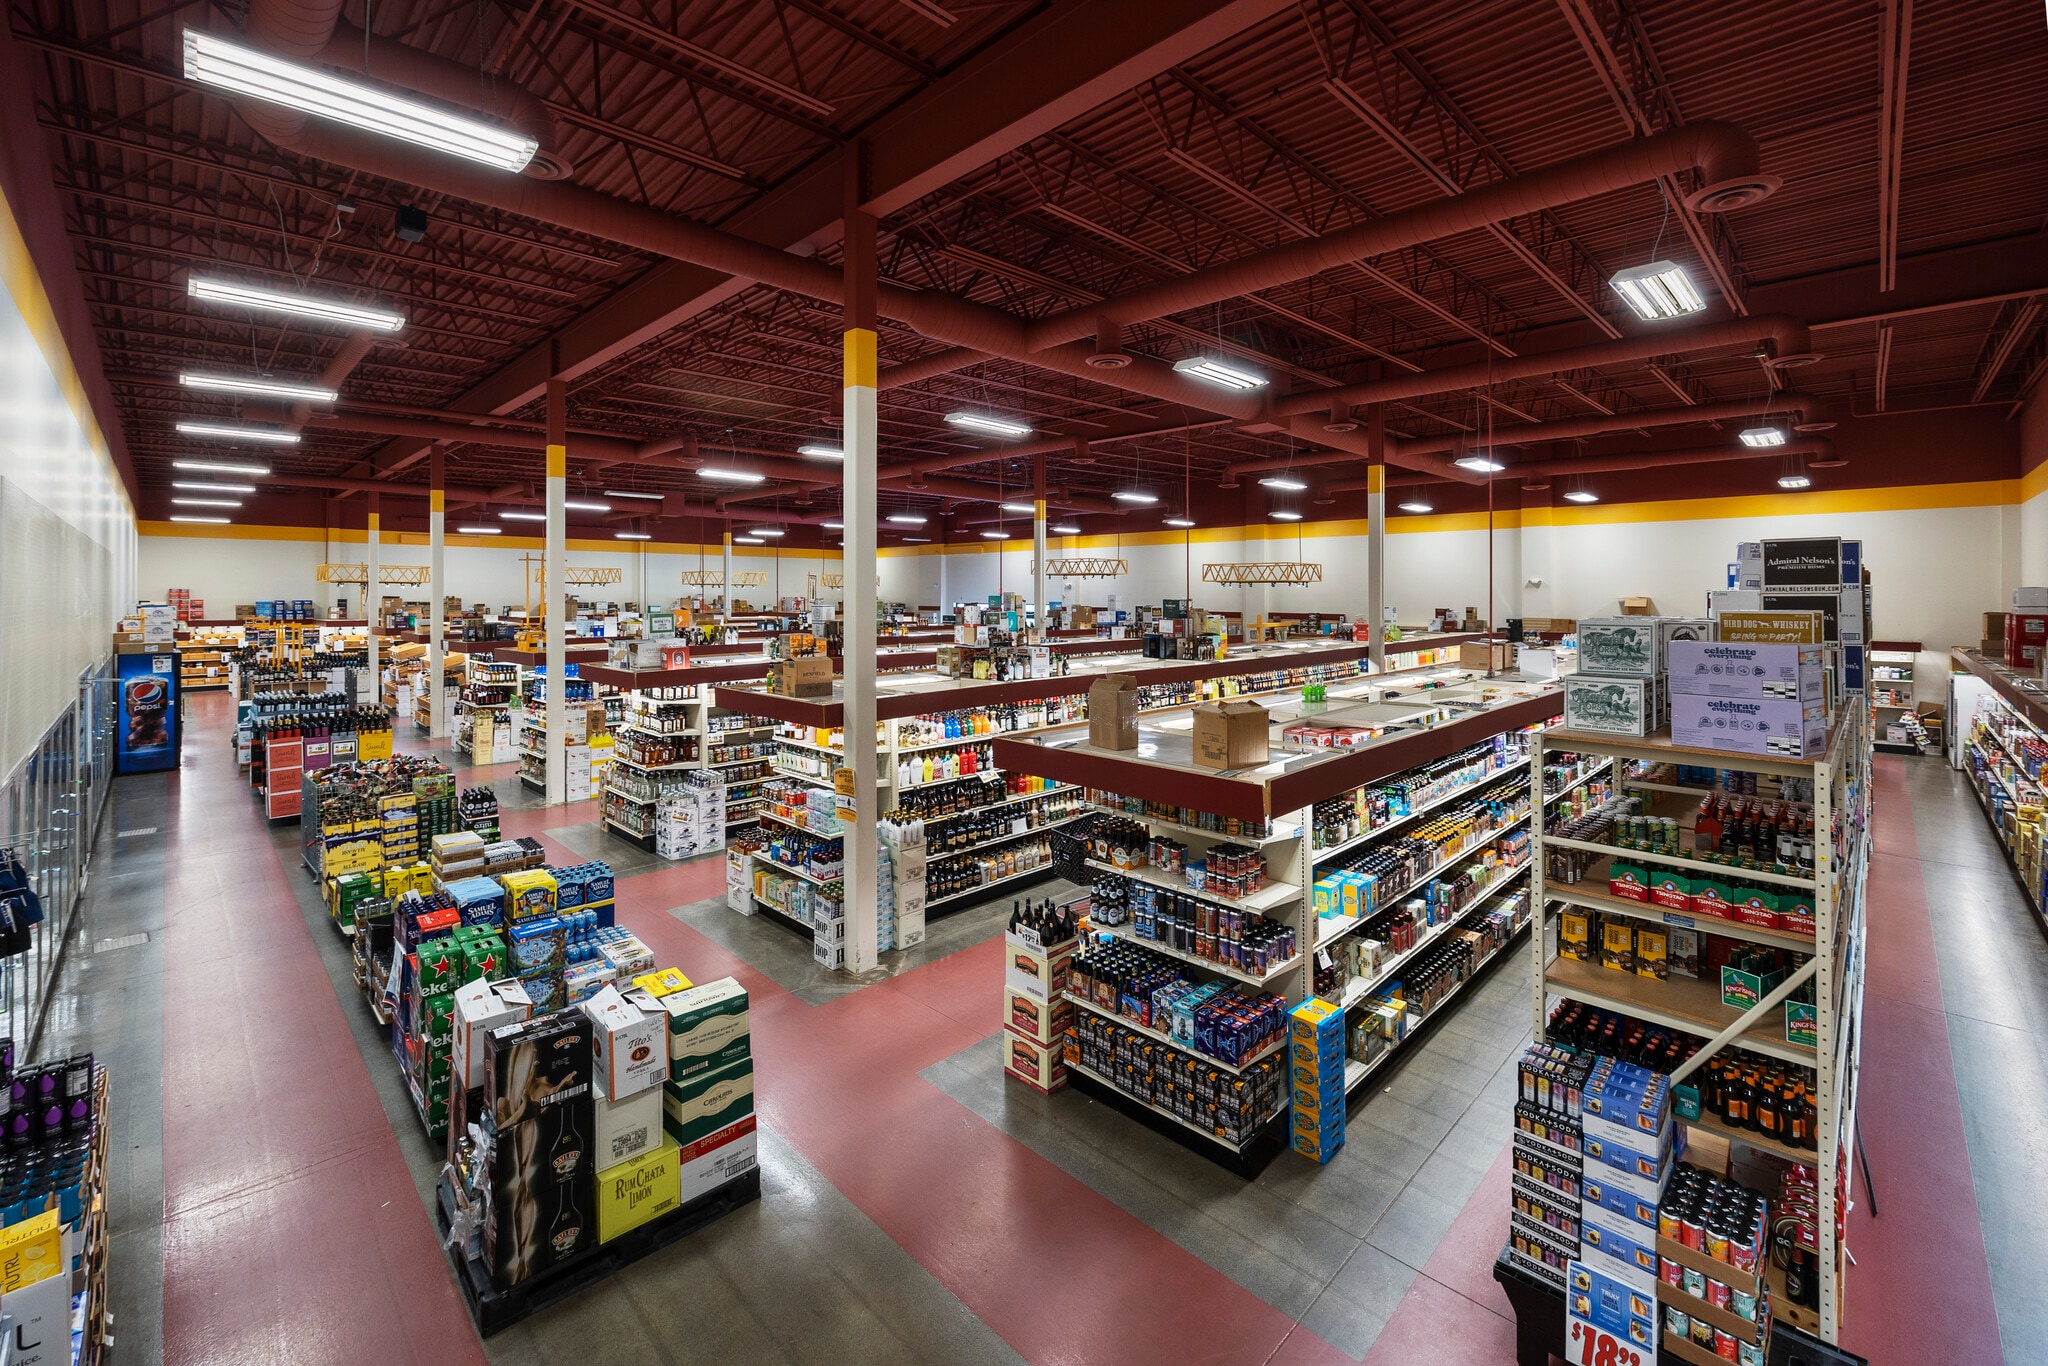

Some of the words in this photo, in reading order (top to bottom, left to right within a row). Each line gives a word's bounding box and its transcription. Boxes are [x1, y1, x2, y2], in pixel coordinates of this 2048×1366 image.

[1767, 558, 1800, 566] Admiral
[1801, 556, 1835, 565] Nelson's
[1723, 619, 1742, 628] BIRD
[1743, 620, 1758, 628] DOG
[1772, 620, 1810, 630] WHISKEY
[1730, 632, 1757, 641] BRING
[1768, 631, 1802, 643] PARTY!
[1704, 647, 1757, 656] celebrate
[1708, 653, 1753, 661] everything
[133, 703, 161, 712] pepsi
[1707, 700, 1761, 711] celebrate
[1711, 706, 1757, 716] everything
[590, 878, 611, 888] SAMUEL
[592, 883, 609, 892] ADAMS
[1615, 882, 1643, 892] TSINGTAO
[526, 890, 545, 899] SAMUEL
[558, 885, 580, 894] SAMUEL
[560, 890, 578, 899] ADAMS
[1655, 890, 1685, 901] TSINGTAO
[467, 902, 497, 915] SAMUEL
[1696, 898, 1727, 909] TSINGTAO
[470, 909, 495, 920] ADAMS
[1740, 907, 1773, 919] TSINGTAO
[516, 916, 537, 924] SAMUEL
[1785, 915, 1816, 927] TSINGTA
[521, 948, 551, 961] ORCHARD
[526, 946, 547, 955] ANGRY
[520, 966, 535, 974] CRISP
[535, 963, 552, 971] APPLE
[1725, 984, 1758, 1000] KINGFISHER
[534, 1004, 550, 1013] APPLE
[627, 1033, 653, 1050] Tito's
[626, 1055, 657, 1074] Handmade
[1679, 1096, 1697, 1106] IMPERIAL
[1610, 1110, 1628, 1119] TRULY
[700, 1125, 738, 1148] SPECIALTY
[1611, 1154, 1628, 1164] TRULY
[629, 1184, 652, 1210] LIMÓN
[1609, 1198, 1627, 1208] TRULY
[1609, 1243, 1626, 1253] TRULY
[1601, 1288, 1620, 1300] TRULY
